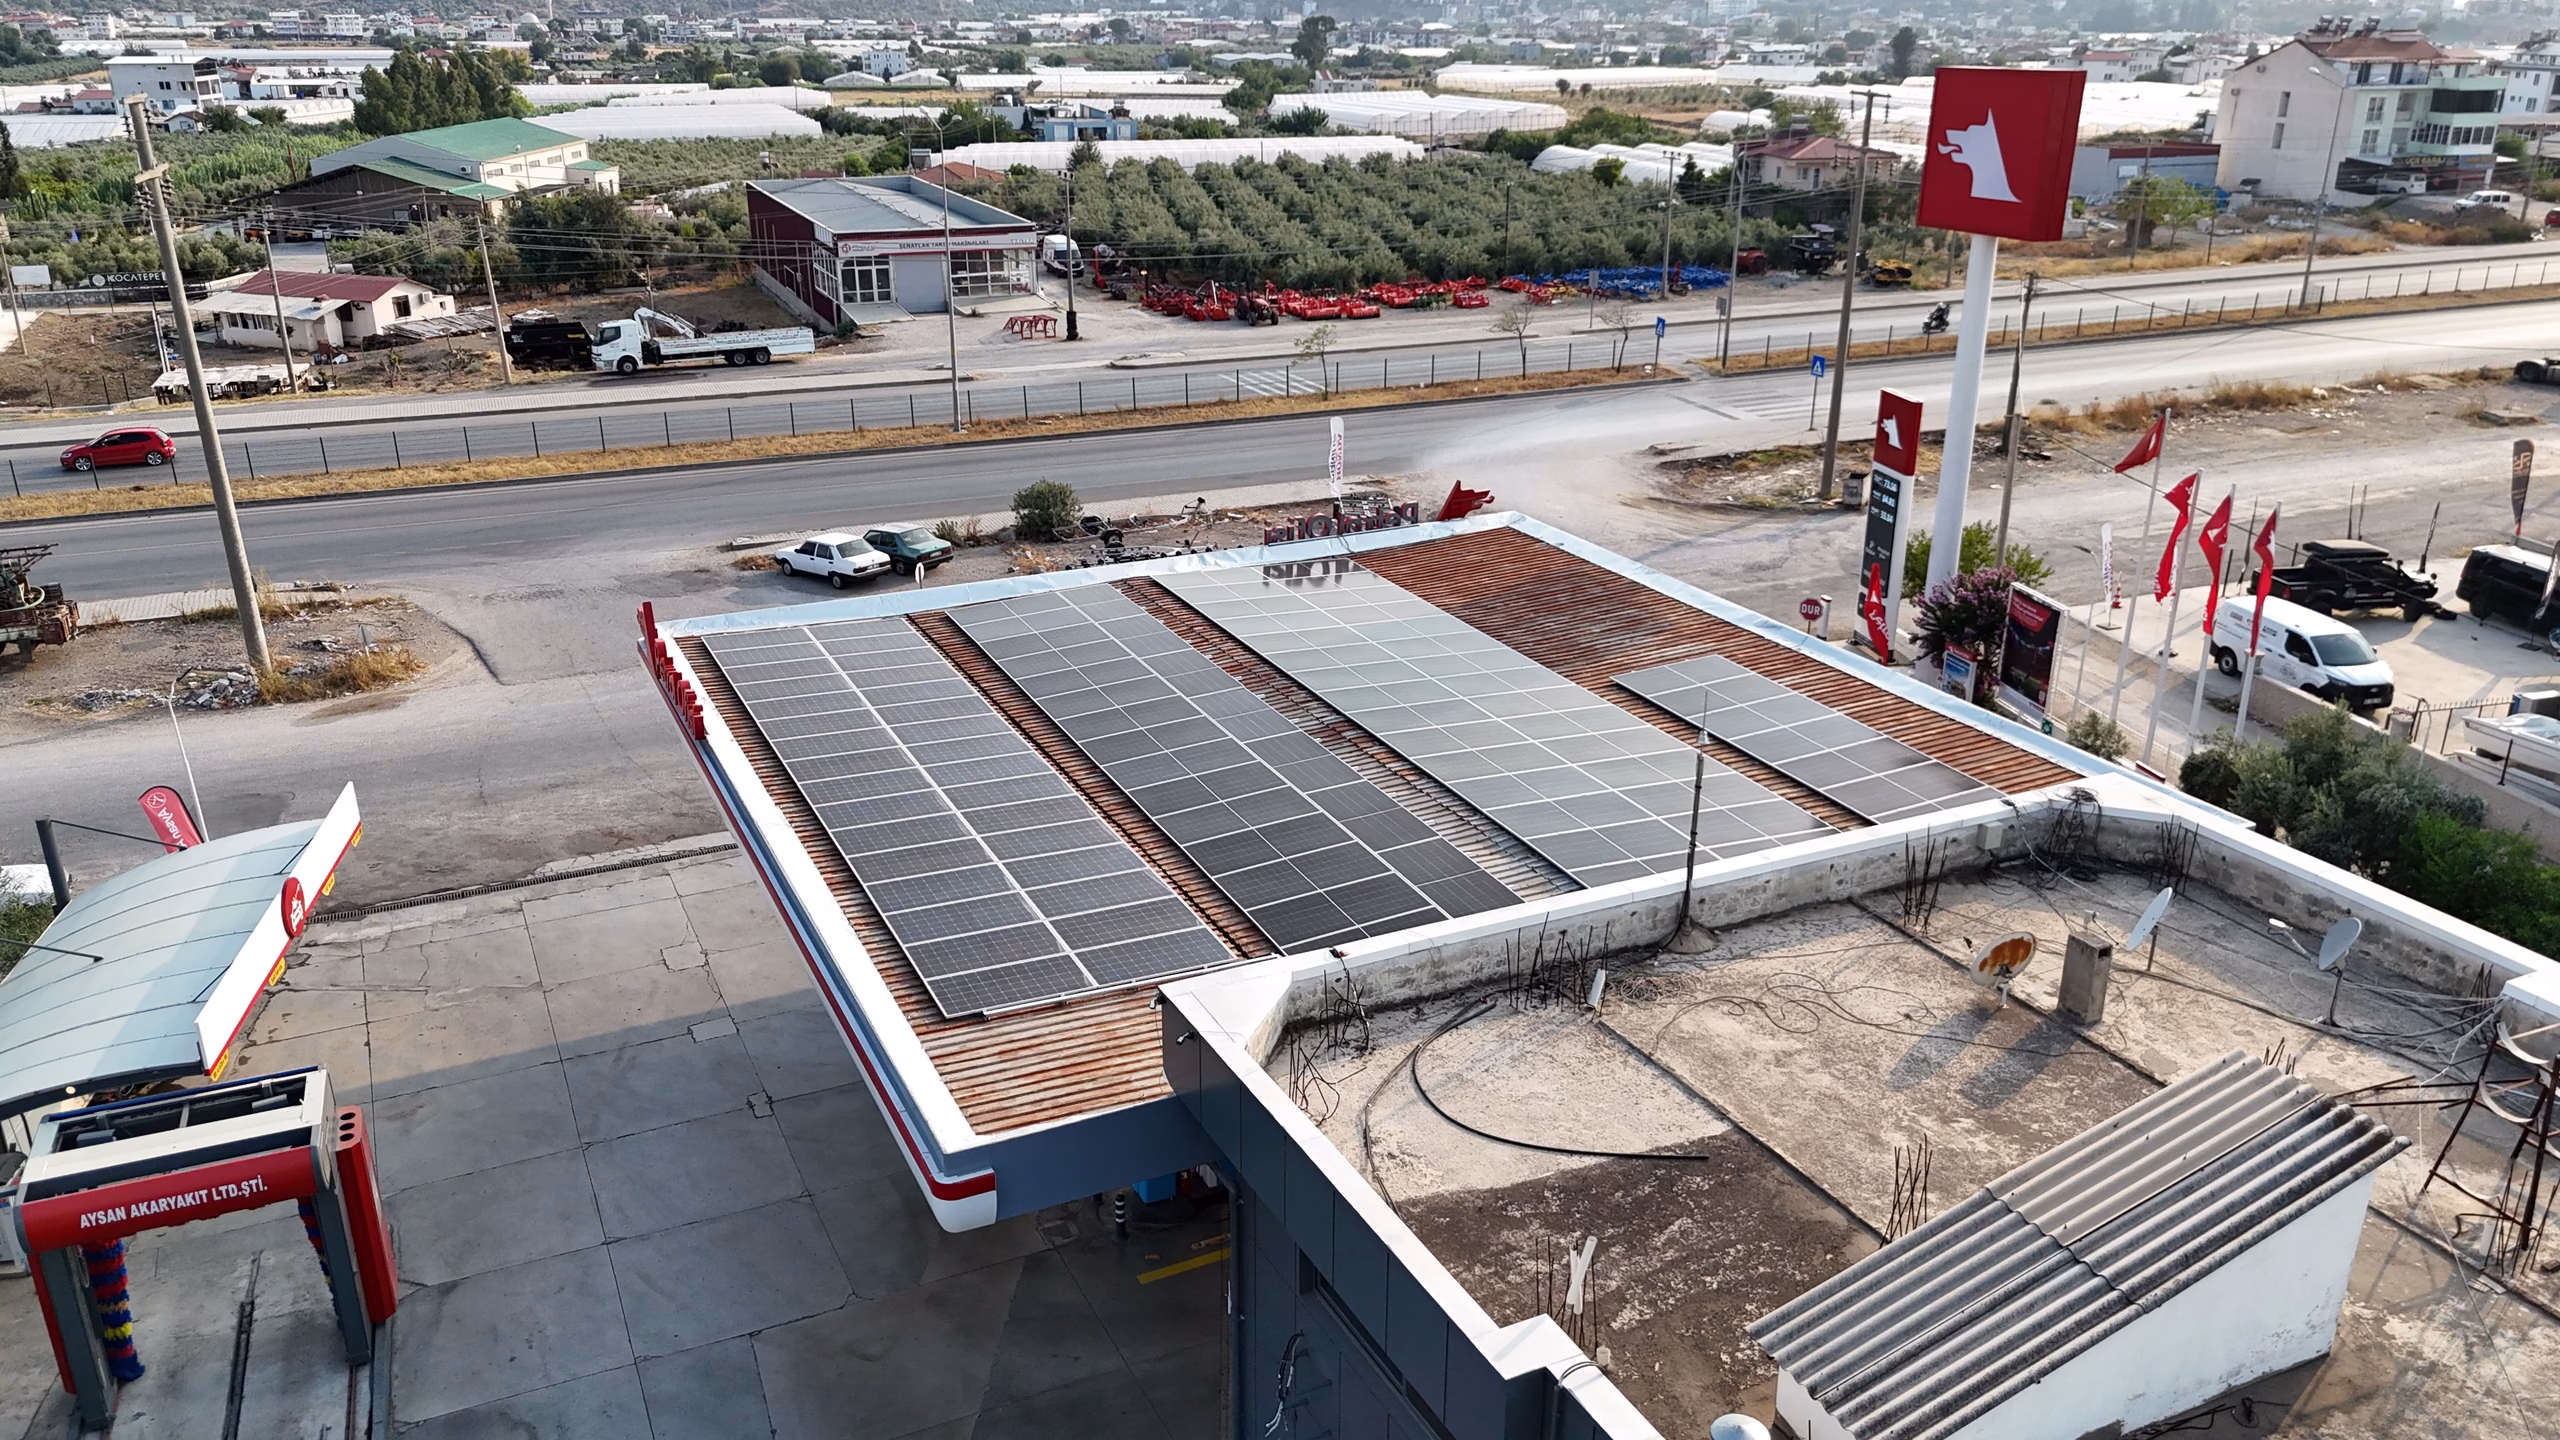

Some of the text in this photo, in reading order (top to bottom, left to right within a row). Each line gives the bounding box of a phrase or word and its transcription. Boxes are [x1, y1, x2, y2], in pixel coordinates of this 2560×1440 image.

[1801, 603, 1820, 616] DUR
[80, 1174, 268, 1229] AYSAN AKARYAKIT LTD.ŞTİ.
